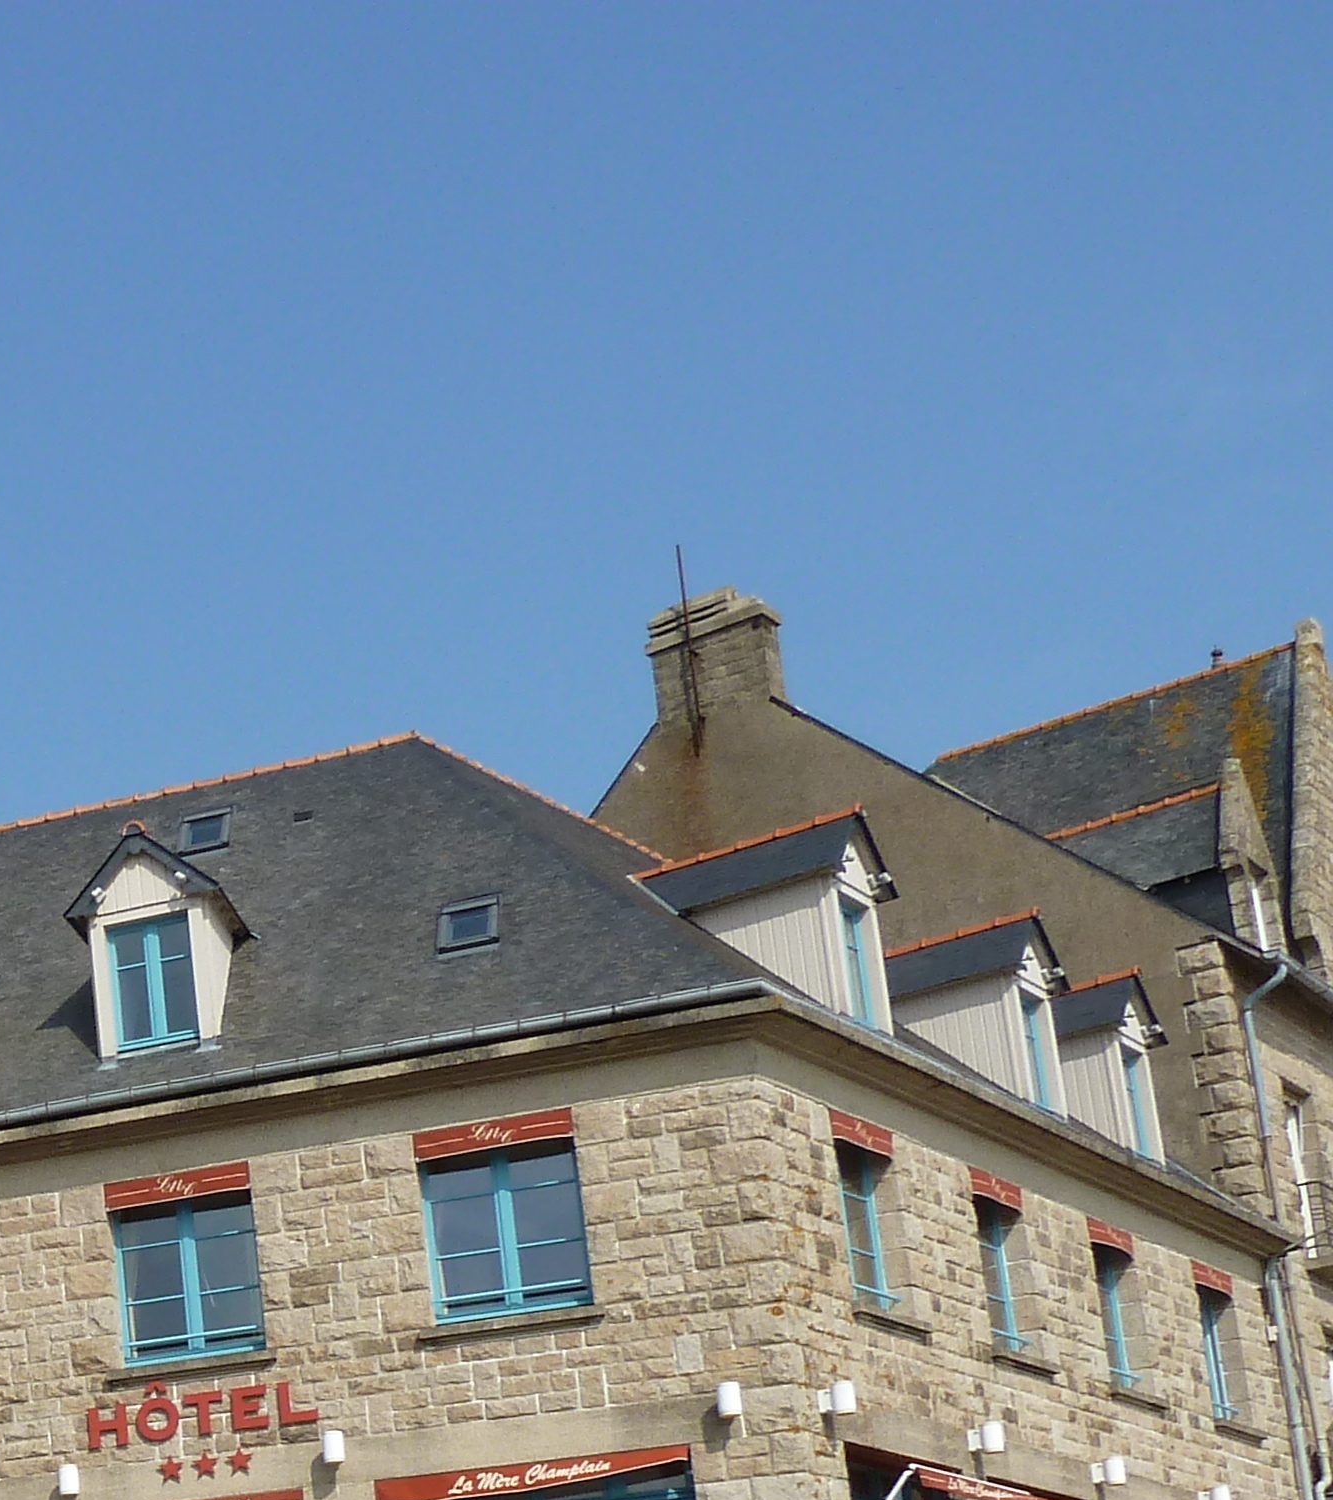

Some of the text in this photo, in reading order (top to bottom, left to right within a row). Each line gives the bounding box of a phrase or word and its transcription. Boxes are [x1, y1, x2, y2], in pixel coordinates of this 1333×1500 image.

[87, 1381, 319, 1449] HÔTEL
[449, 1460, 611, 1494] La Mère Champlain
